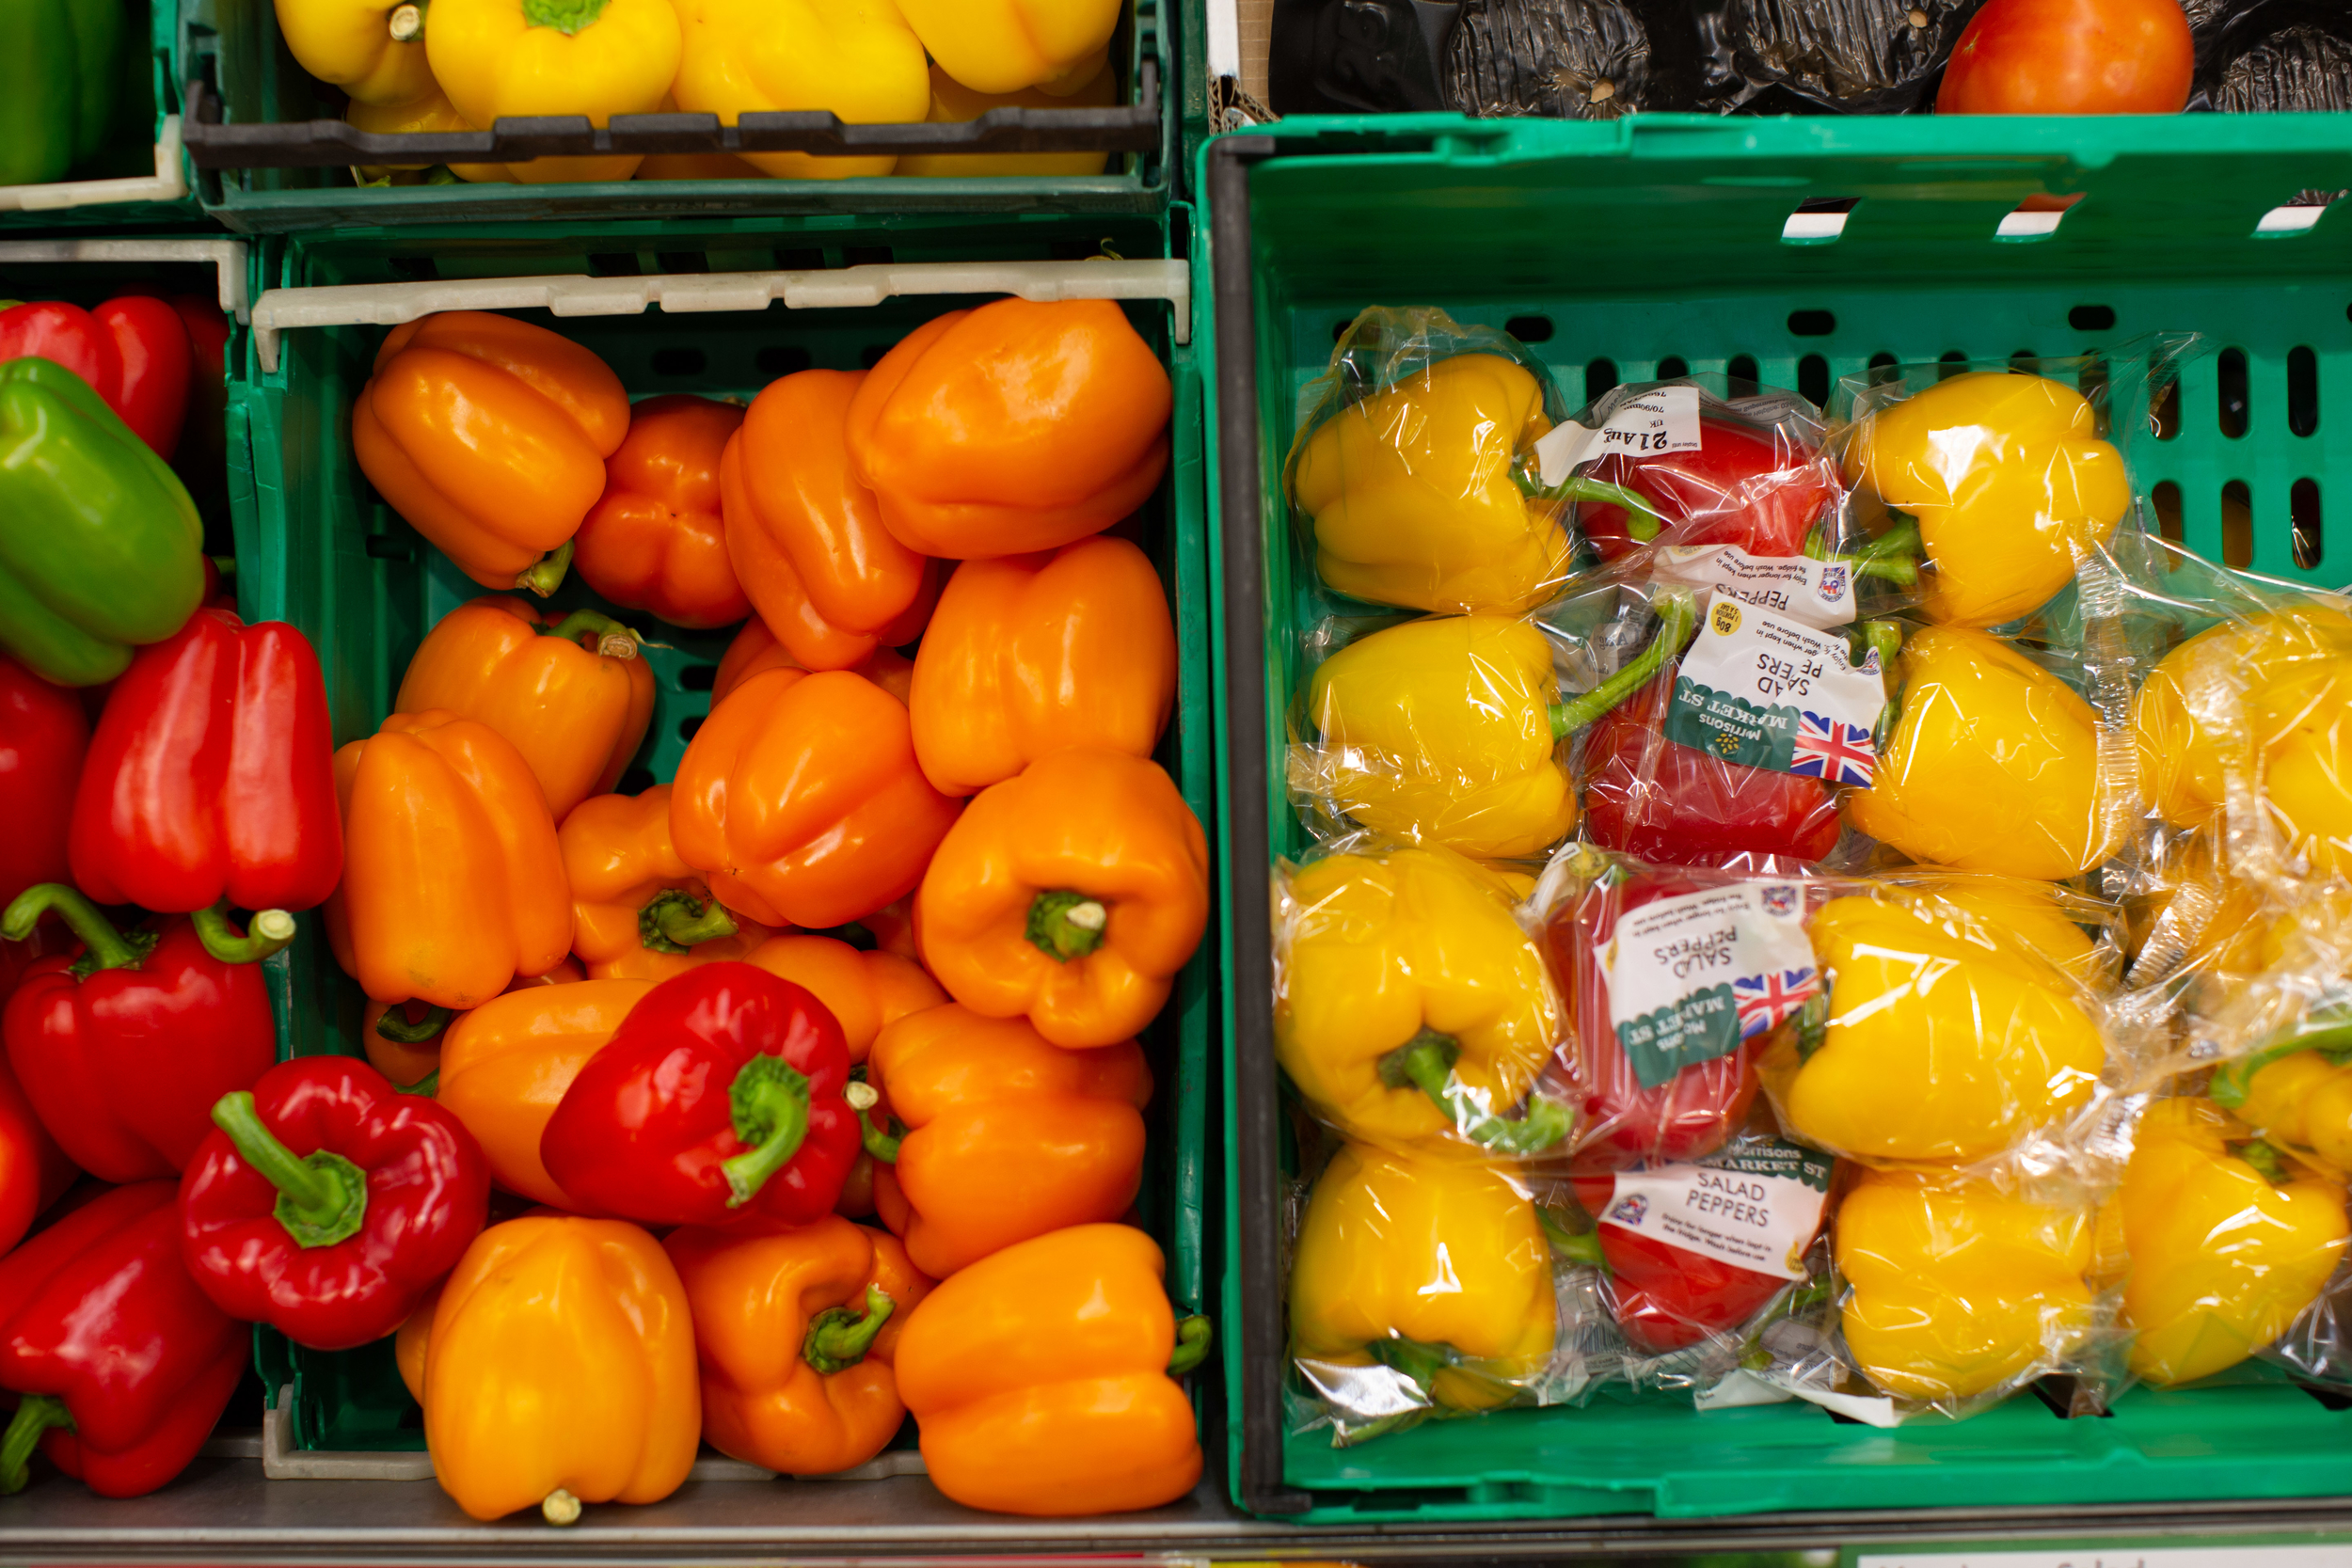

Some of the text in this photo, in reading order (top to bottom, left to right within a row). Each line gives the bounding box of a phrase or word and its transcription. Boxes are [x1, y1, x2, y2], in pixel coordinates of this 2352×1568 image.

[1648, 419, 1664, 429] UK
[1603, 428, 1668, 451] 21 Aug
[1715, 557, 1724, 566] in
[1724, 550, 1735, 561] use
[1722, 562, 1736, 576] kept
[1734, 559, 1755, 571] before
[1737, 572, 1756, 580] when
[1792, 574, 1807, 586] Enjoy
[1715, 583, 1790, 611] PEPPERS
[1720, 603, 1730, 611] DAY
[1716, 616, 1731, 633] 80g
[1761, 620, 1775, 630] use
[1756, 628, 1764, 638] in
[1764, 632, 1782, 644] kept
[1776, 626, 1801, 641] before
[1782, 640, 1803, 651] when
[1802, 636, 1821, 650] Wash
[1830, 653, 1847, 672] Enjoy
[1678, 689, 1706, 707] ST
[1654, 926, 1738, 965] PEPPERS
[1673, 946, 1732, 978] SALAD
[1629, 1024, 1654, 1046] ST
[1804, 1162, 1827, 1179] ST
[1696, 1172, 1765, 1201] SALAD
[1686, 1189, 1769, 1227] PEPPERS
